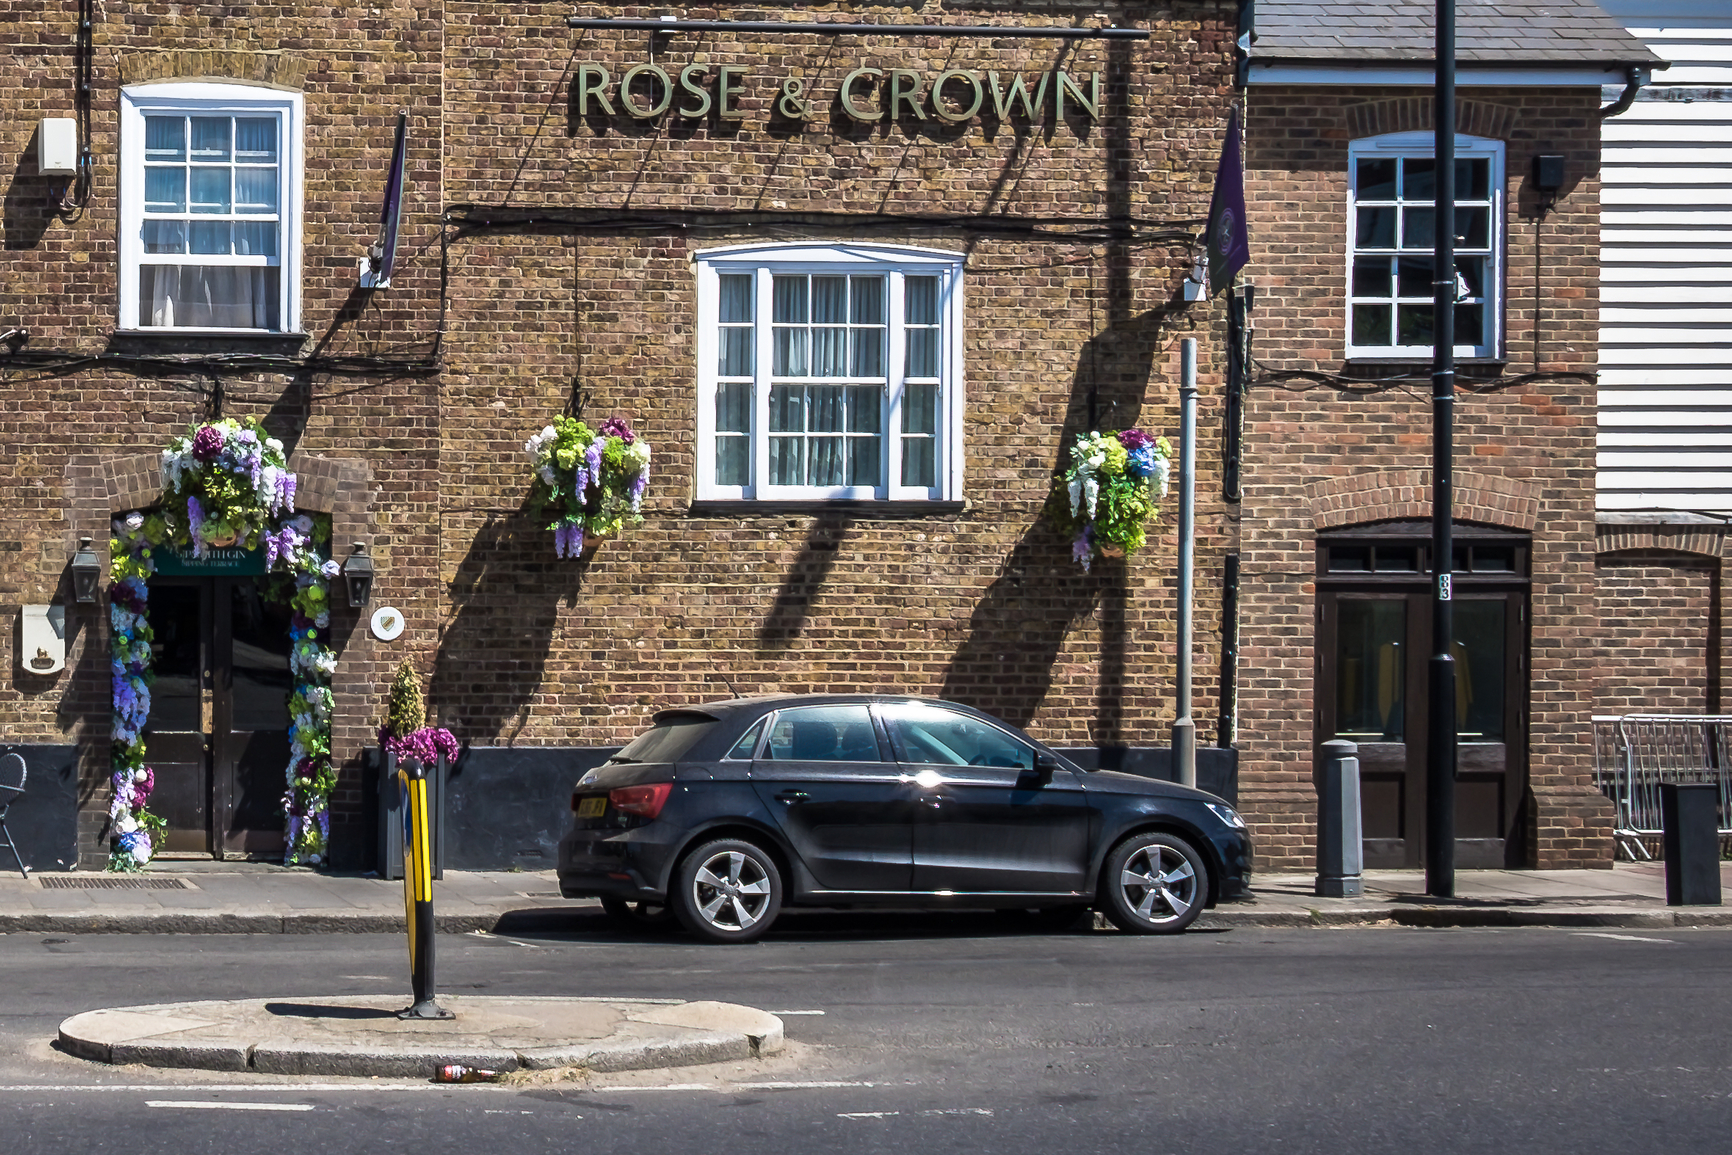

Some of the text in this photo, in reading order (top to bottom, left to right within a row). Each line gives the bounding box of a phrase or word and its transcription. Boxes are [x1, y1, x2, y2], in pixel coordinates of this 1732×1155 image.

[578, 63, 1100, 123] ROSE & CROWN
[226, 549, 246, 559] GIN
